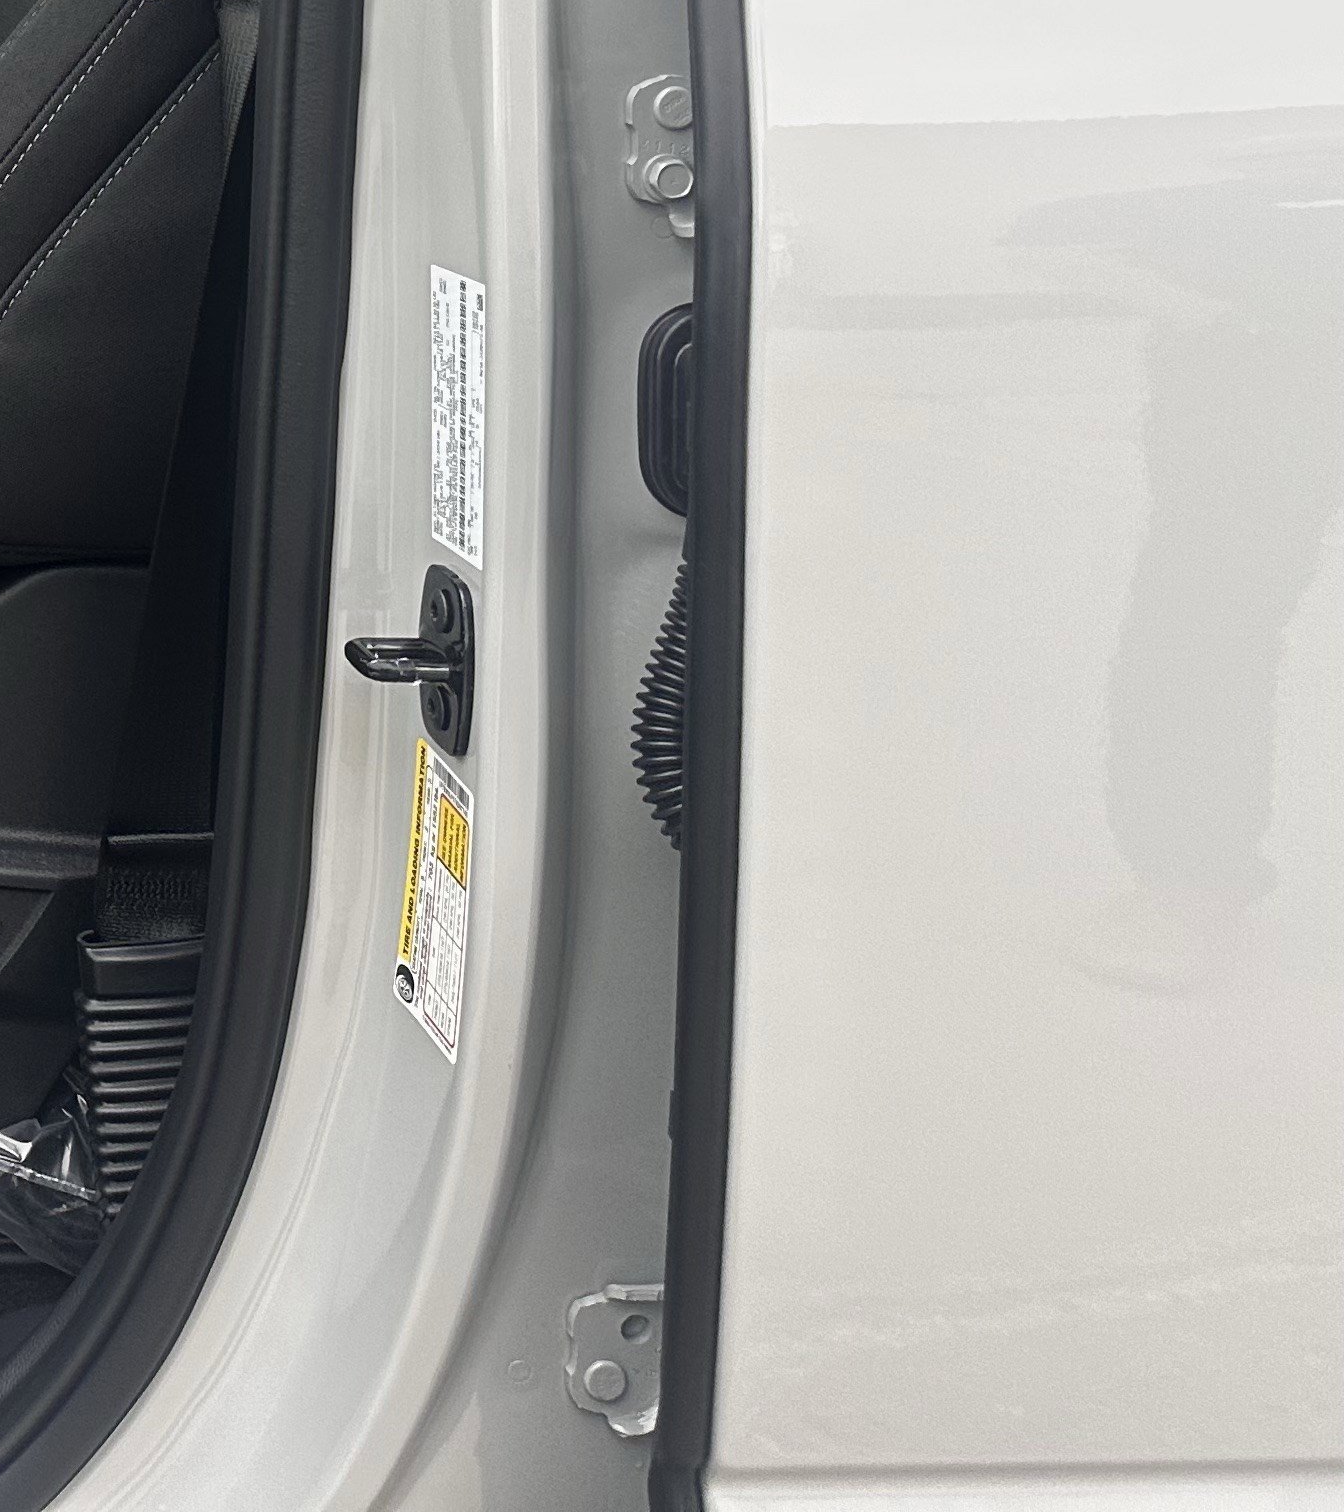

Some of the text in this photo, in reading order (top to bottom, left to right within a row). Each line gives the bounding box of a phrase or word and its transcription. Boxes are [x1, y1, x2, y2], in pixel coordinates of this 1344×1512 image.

[413, 745, 427, 835] INFORMATION
[410, 836, 420, 895] LOADING
[406, 895, 415, 924] AND
[402, 924, 411, 958] TIRE
